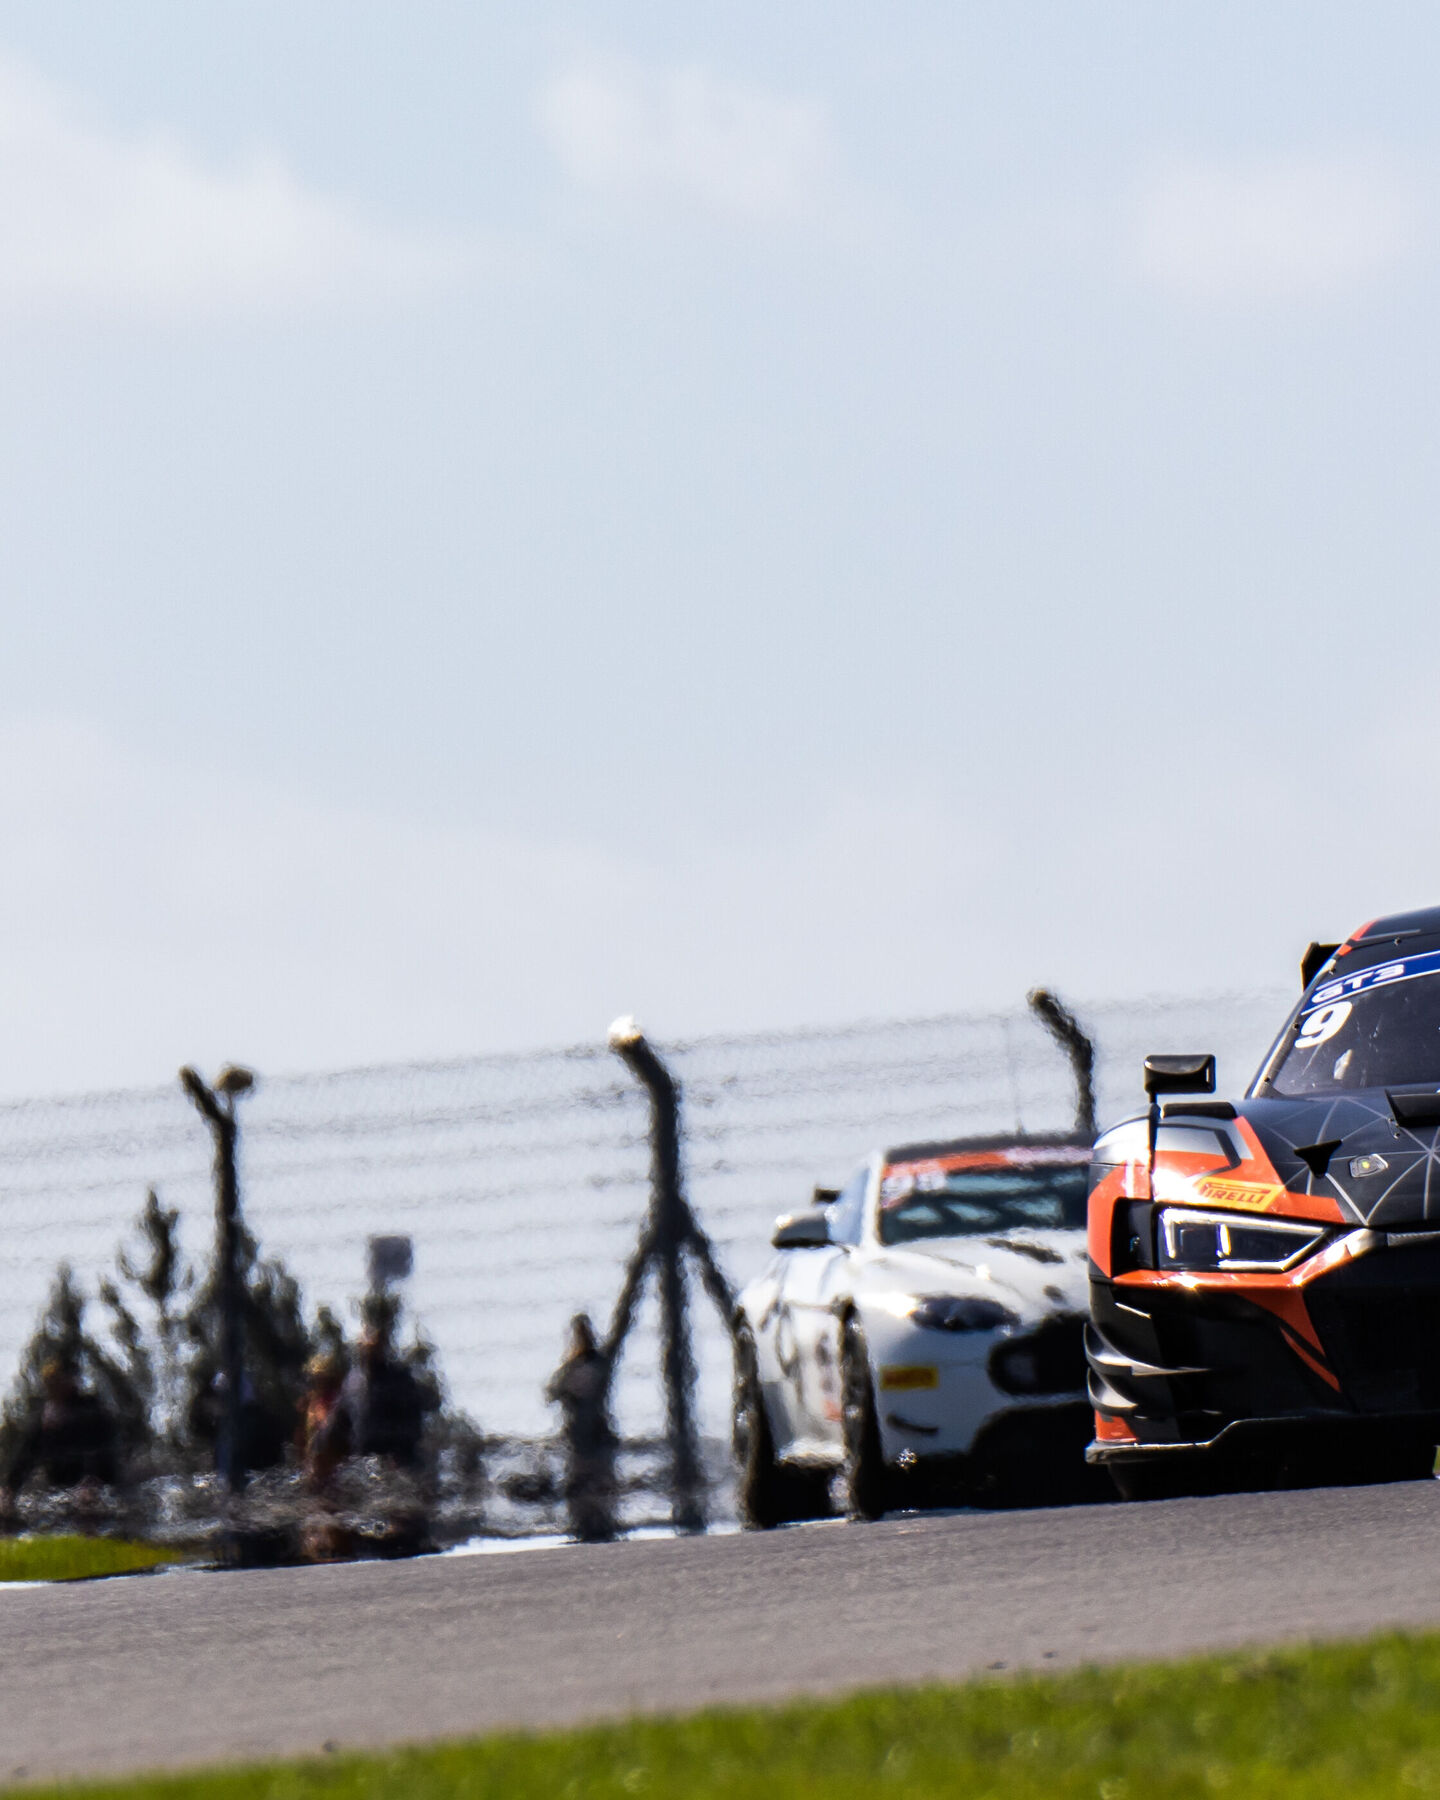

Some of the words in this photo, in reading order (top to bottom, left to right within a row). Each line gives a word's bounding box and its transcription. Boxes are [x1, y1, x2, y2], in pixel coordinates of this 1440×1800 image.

[1311, 964, 1405, 1003] GT3
[1294, 1001, 1353, 1048] 9
[1198, 1182, 1272, 1204] PIRELLI
